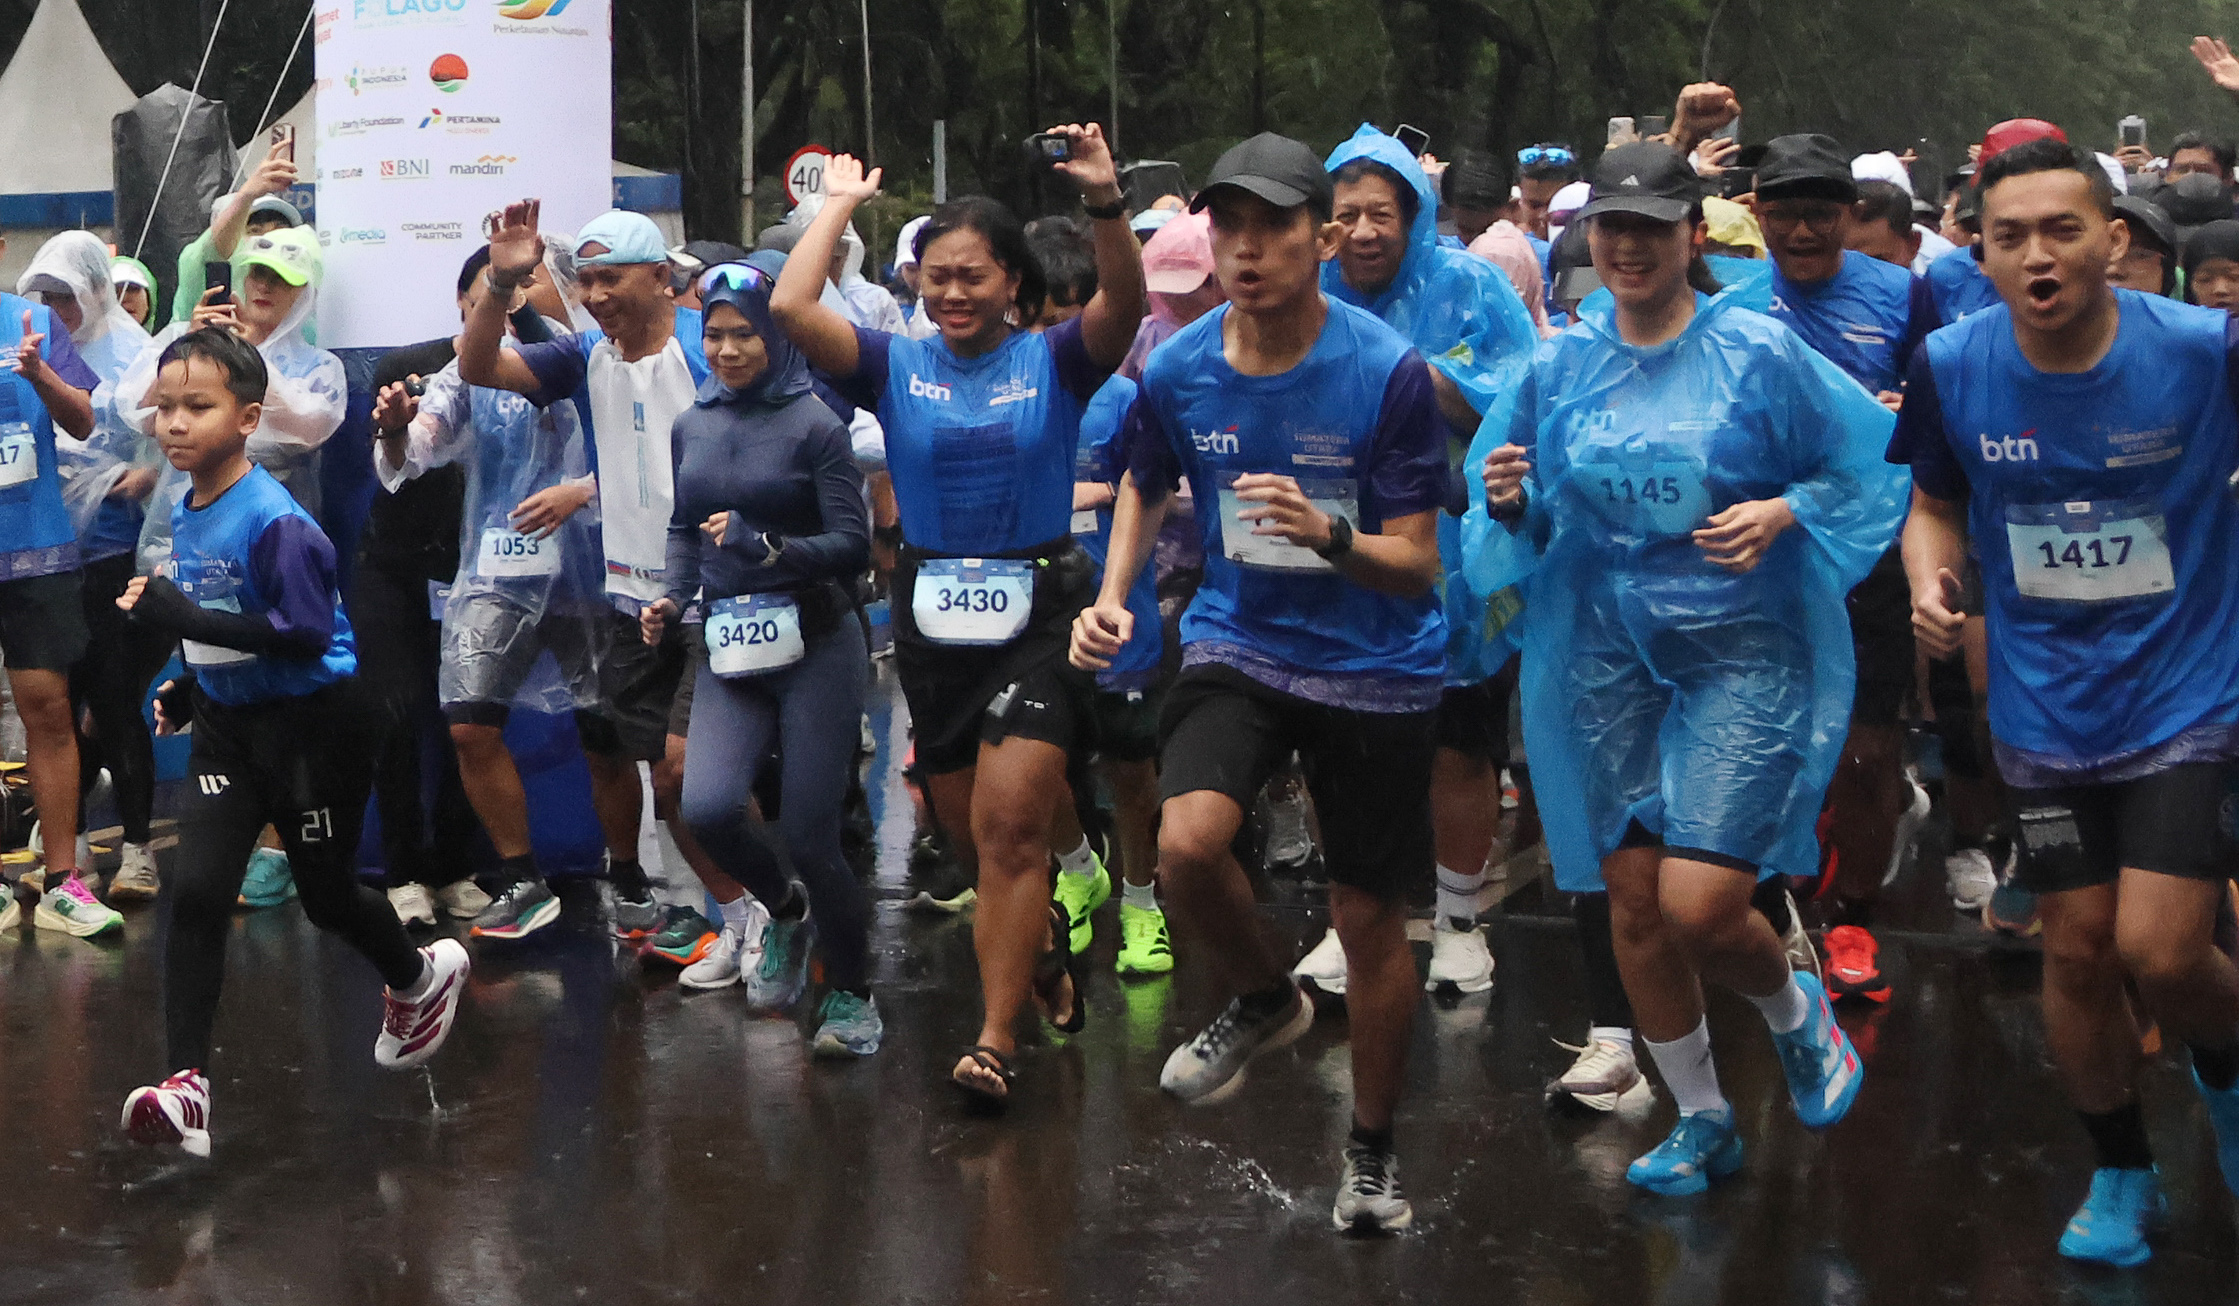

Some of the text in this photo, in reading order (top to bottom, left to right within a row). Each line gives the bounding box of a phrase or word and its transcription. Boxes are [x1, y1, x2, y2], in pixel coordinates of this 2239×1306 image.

[446, 116, 501, 124] PERTAMINA
[397, 159, 430, 175] BNI
[450, 162, 503, 175] mandiri
[792, 166, 820, 193] 40
[401, 222, 463, 232] COMMUNITY
[416, 232, 463, 240] PARTNER
[909, 373, 951, 401] btn
[1191, 427, 1240, 455] btn
[1979, 432, 2039, 462] btn
[1600, 477, 1680, 504] 1145
[494, 536, 540, 556] 1053
[2038, 535, 2133, 568] 1417
[937, 588, 1008, 613] 3430
[719, 619, 778, 648] 3420
[301, 807, 333, 842] 21
